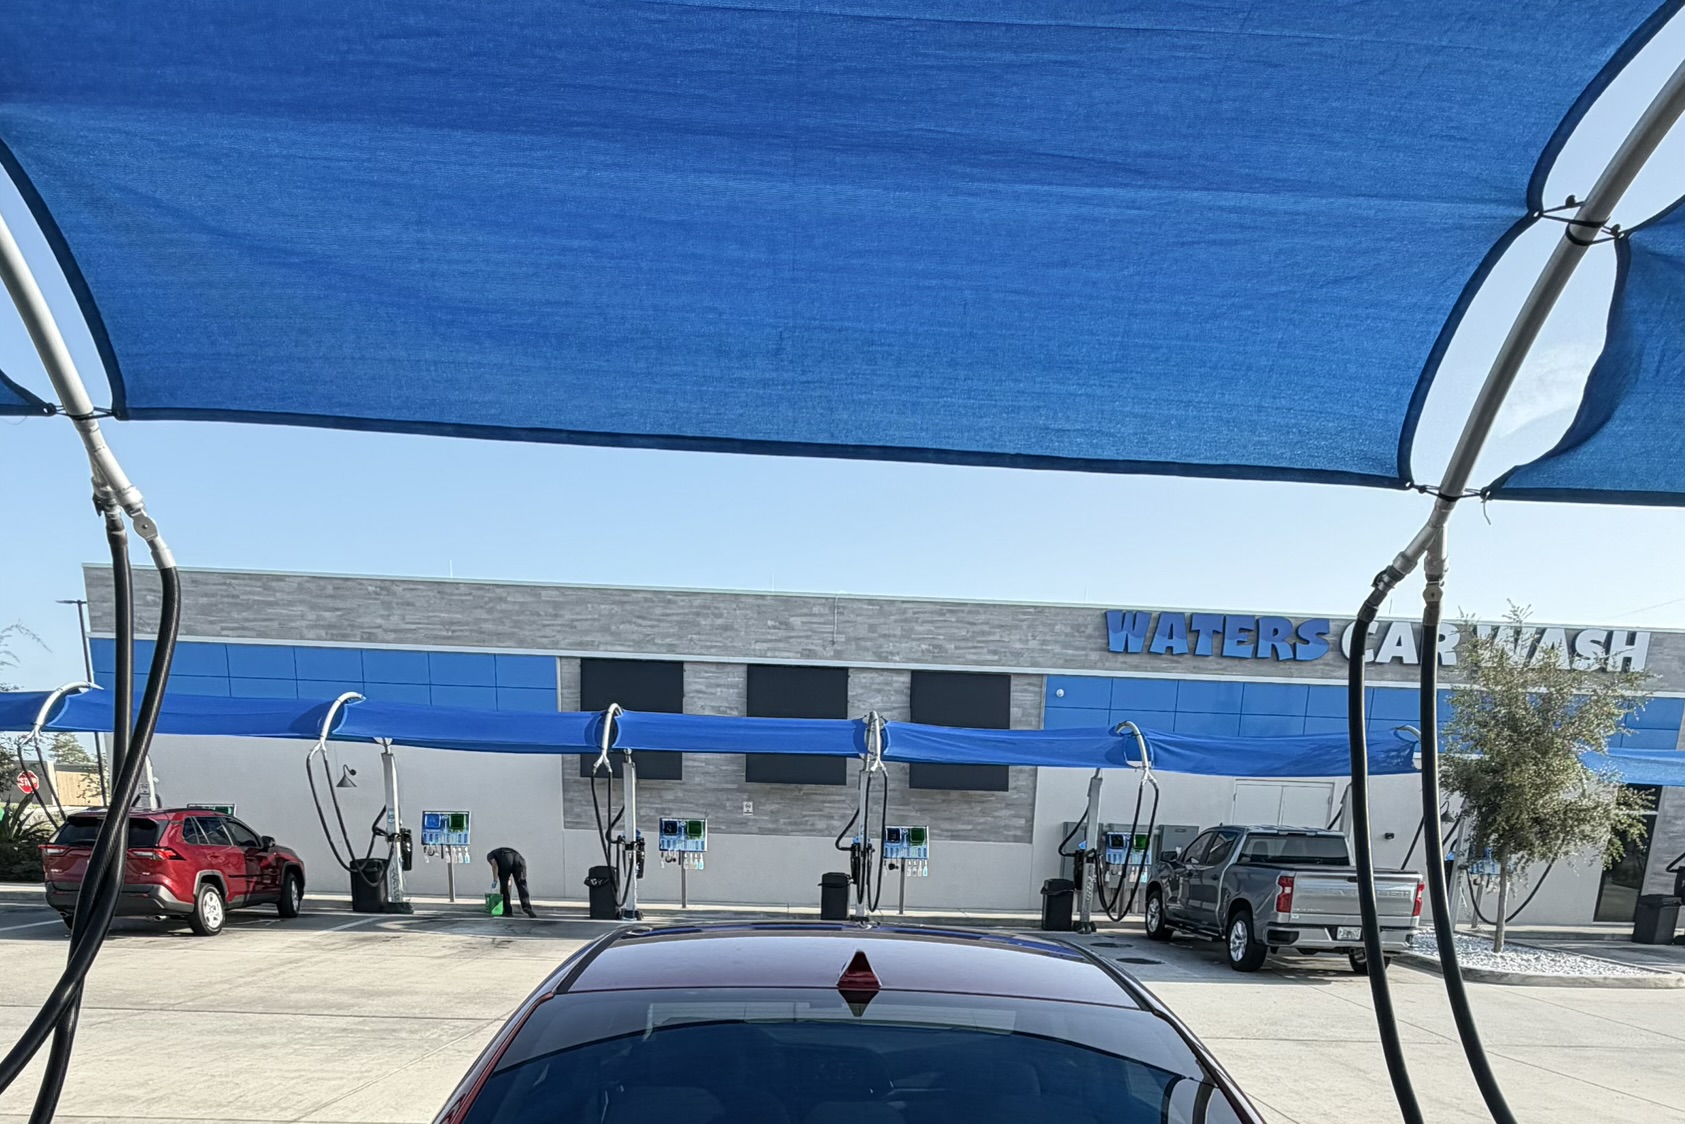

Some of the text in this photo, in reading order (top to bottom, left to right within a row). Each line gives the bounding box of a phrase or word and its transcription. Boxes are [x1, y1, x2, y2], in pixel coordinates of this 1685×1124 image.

[1105, 610, 1652, 673] WATERS CAR WASH
